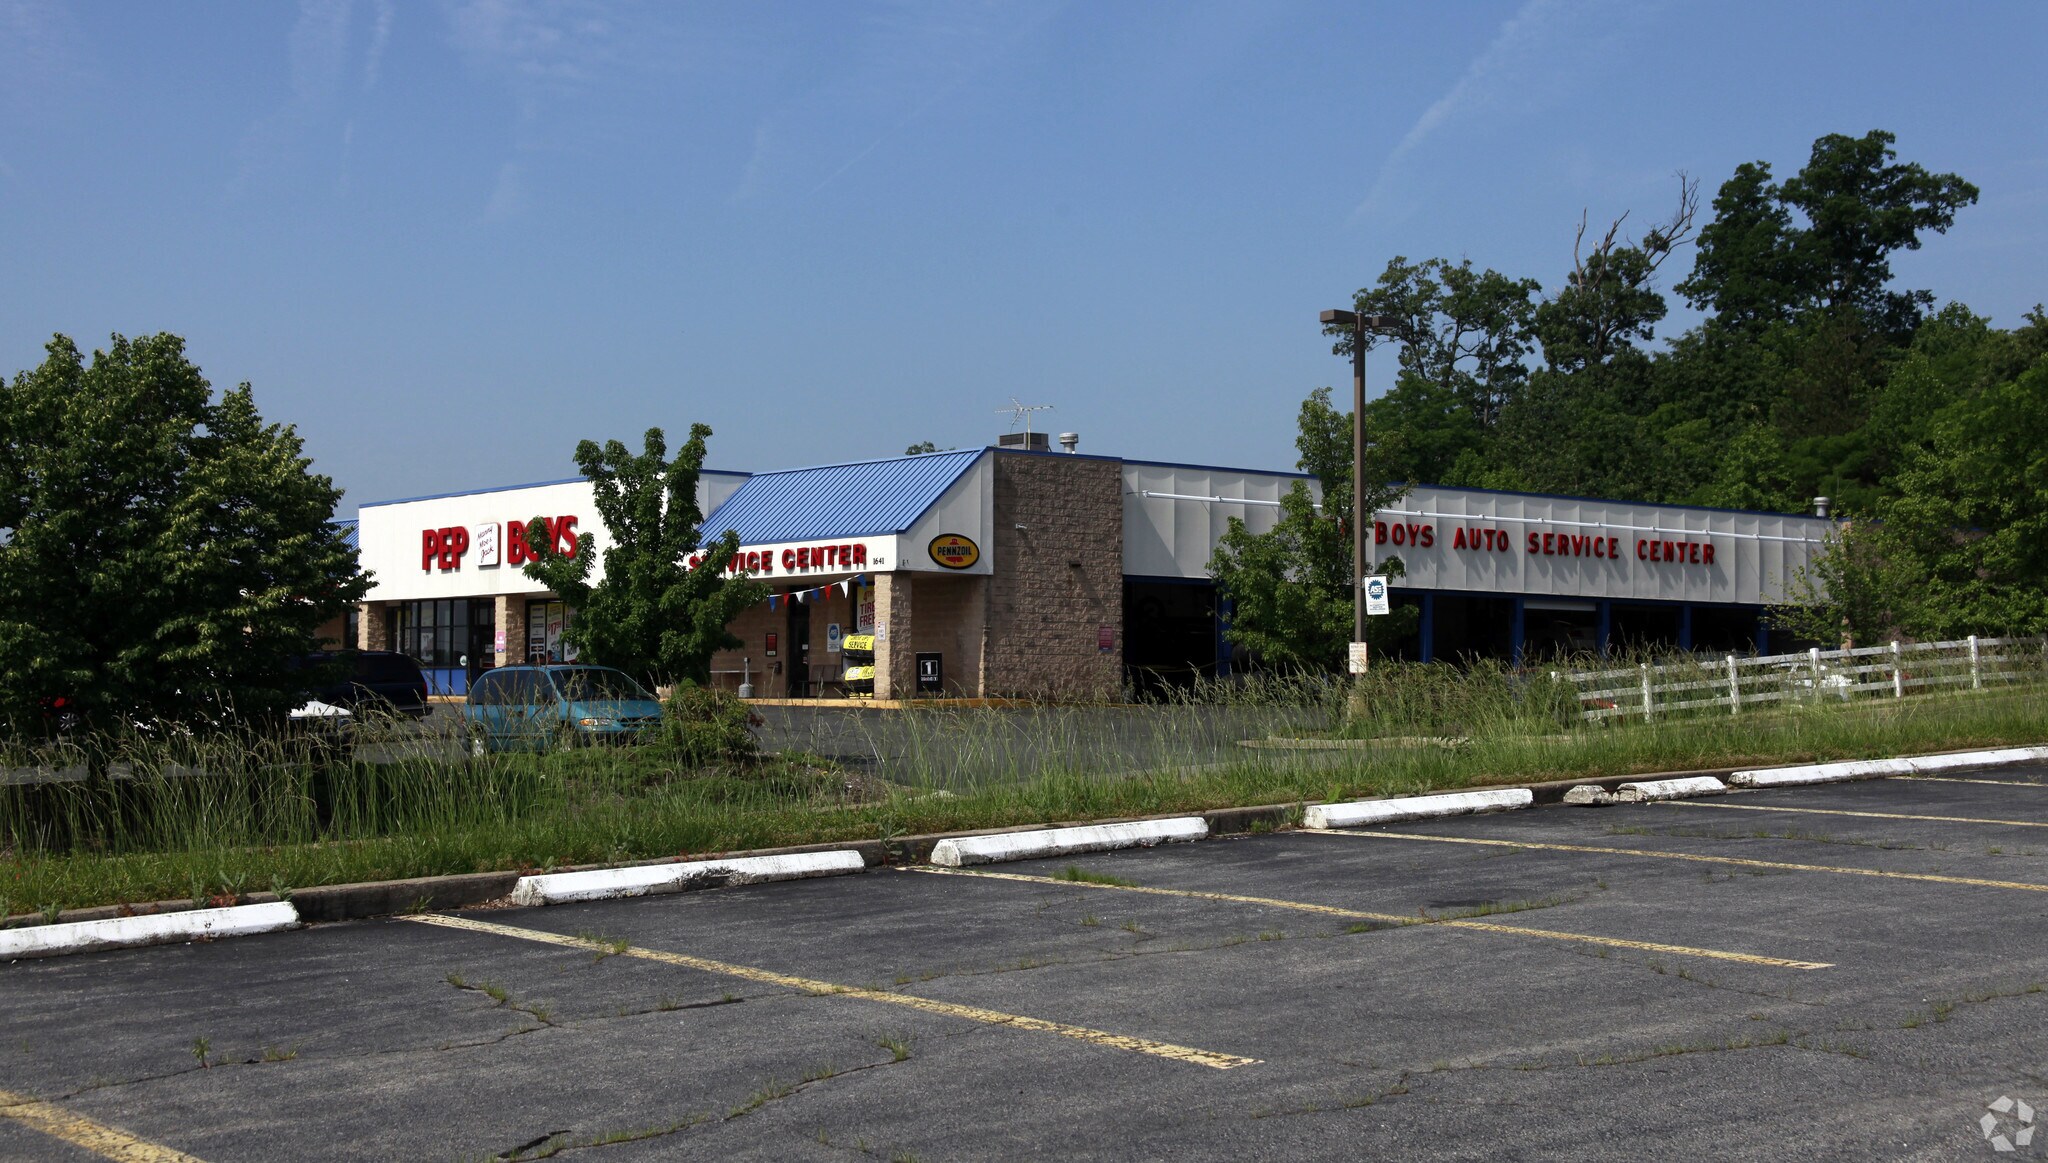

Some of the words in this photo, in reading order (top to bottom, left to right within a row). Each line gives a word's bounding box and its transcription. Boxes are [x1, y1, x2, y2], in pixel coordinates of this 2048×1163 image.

[422, 526, 469, 571] PEP
[1375, 521, 1434, 548] BOYS
[1453, 527, 1509, 552] AUTO
[1528, 532, 1619, 559] SERVICE
[1637, 539, 1715, 565] CENTER
[937, 546, 972, 556] PENNZOIL
[689, 550, 774, 574] SVICE
[781, 543, 868, 569] CENTER
[873, 557, 885, 565] 1641
[1370, 585, 1382, 593] ASE
[925, 661, 932, 675] 1
